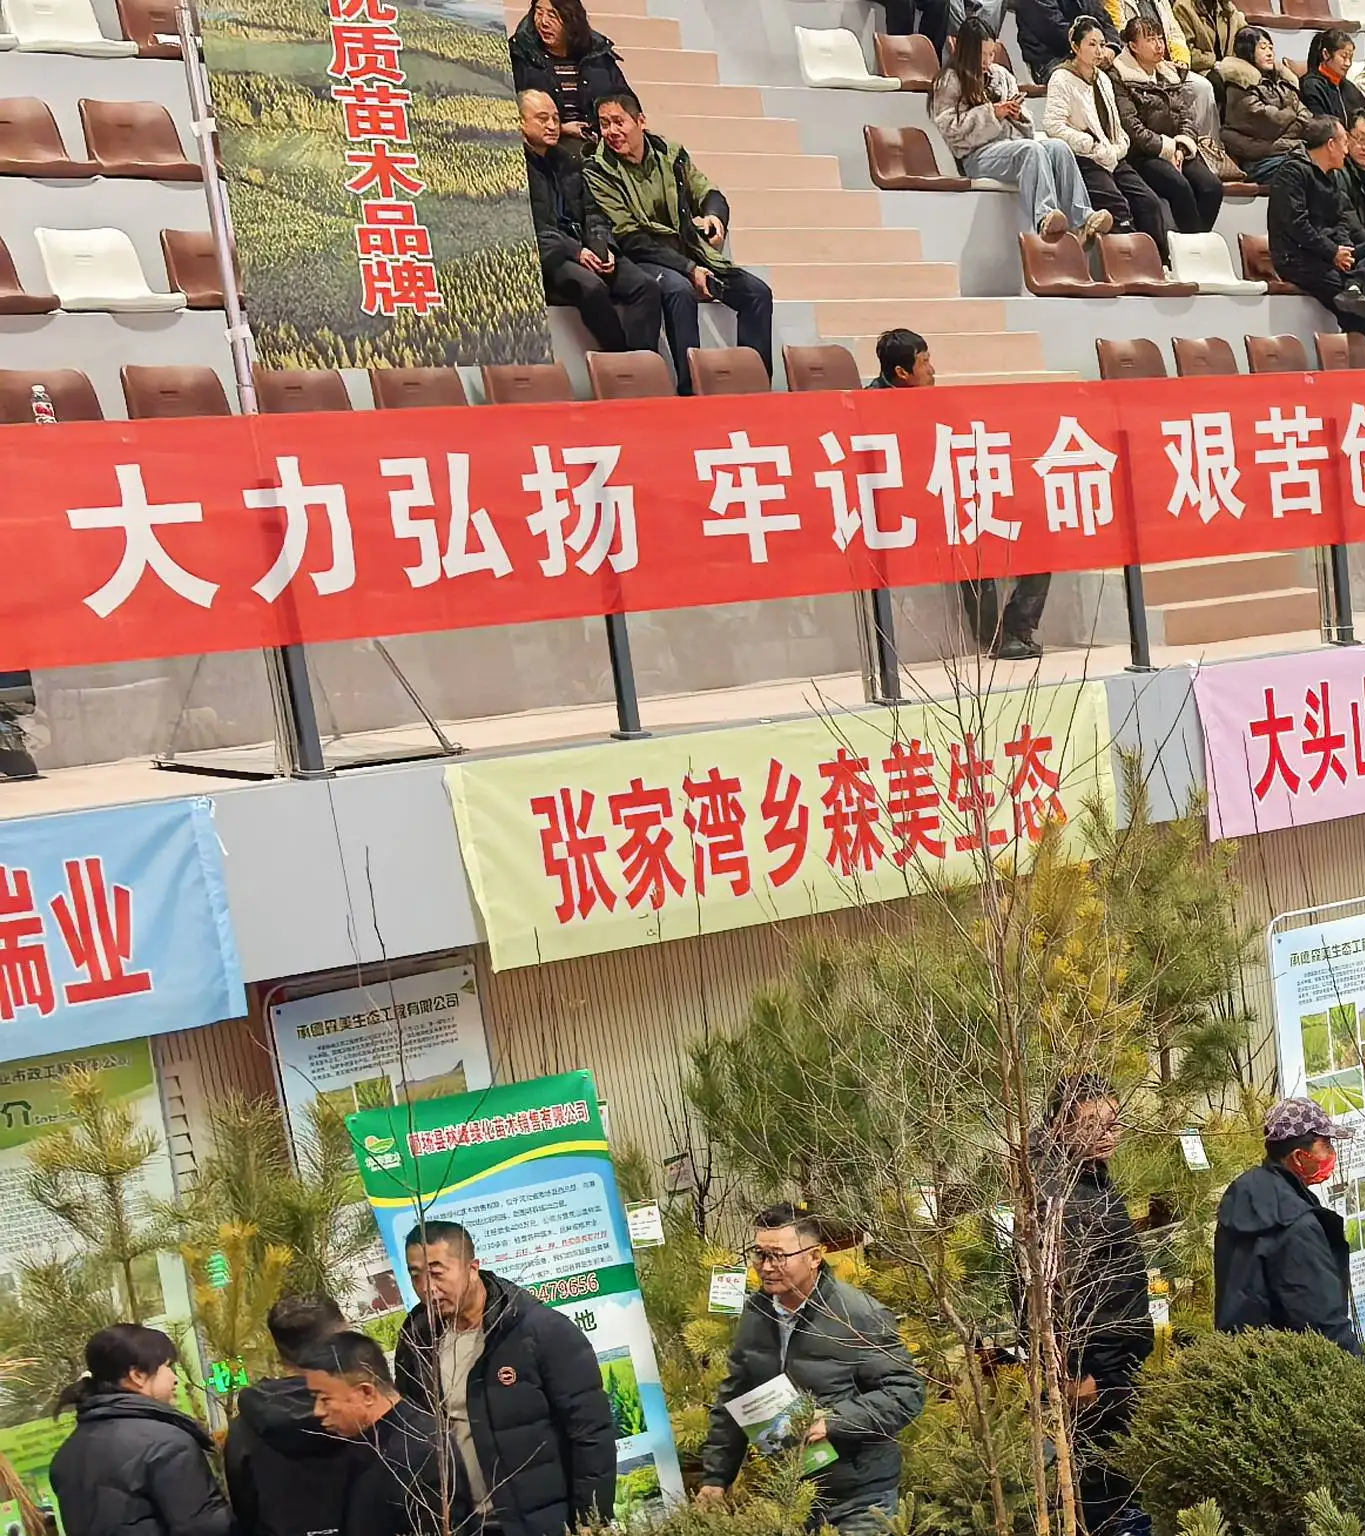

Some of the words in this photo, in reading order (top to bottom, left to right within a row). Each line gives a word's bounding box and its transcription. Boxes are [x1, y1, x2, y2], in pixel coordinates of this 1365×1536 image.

[67, 444, 640, 619] 大力弘扬
[693, 414, 1118, 565] 牢记使命
[530, 724, 1069, 925] 张家湾乡森美生态
